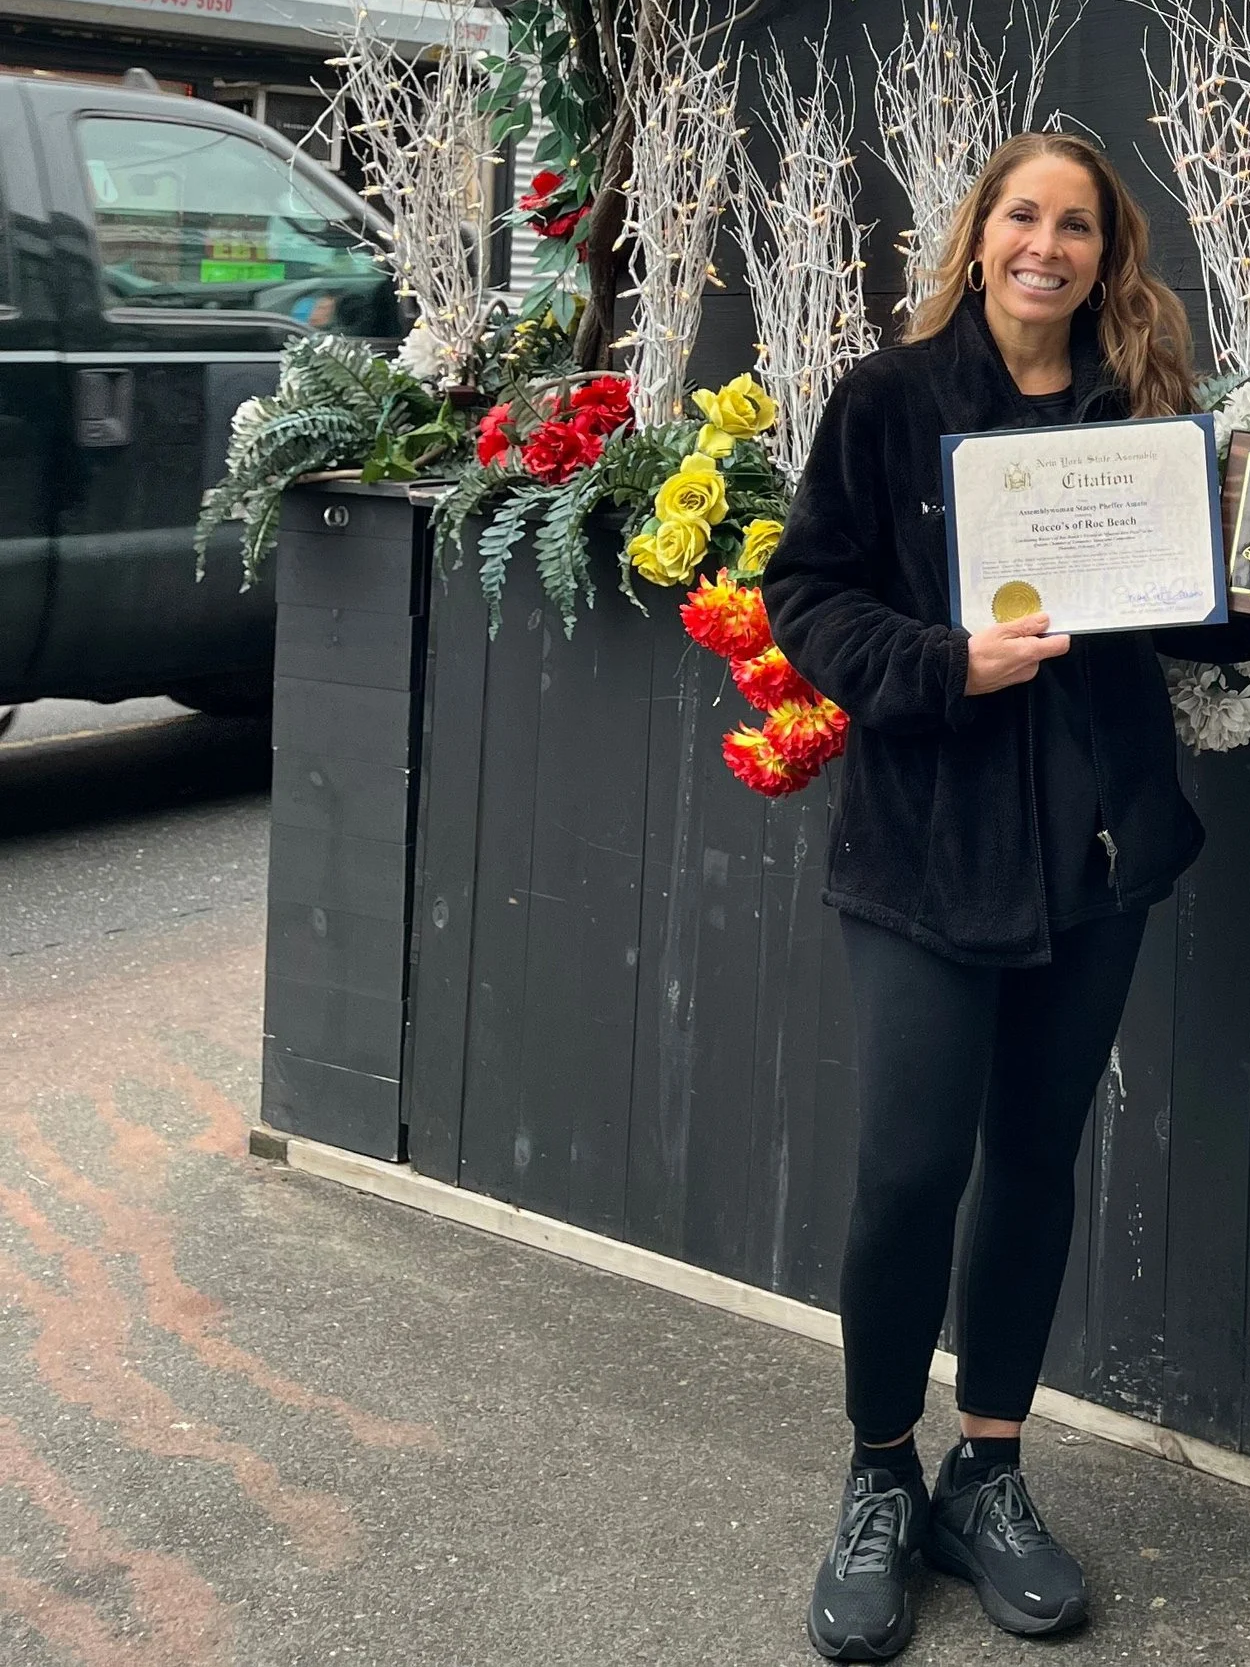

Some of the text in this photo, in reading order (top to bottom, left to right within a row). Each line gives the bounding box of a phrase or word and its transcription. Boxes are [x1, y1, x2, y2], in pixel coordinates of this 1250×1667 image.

[1061, 471, 1134, 489] Citation
[1031, 516, 1137, 533] Rocco's of Roc Beach
